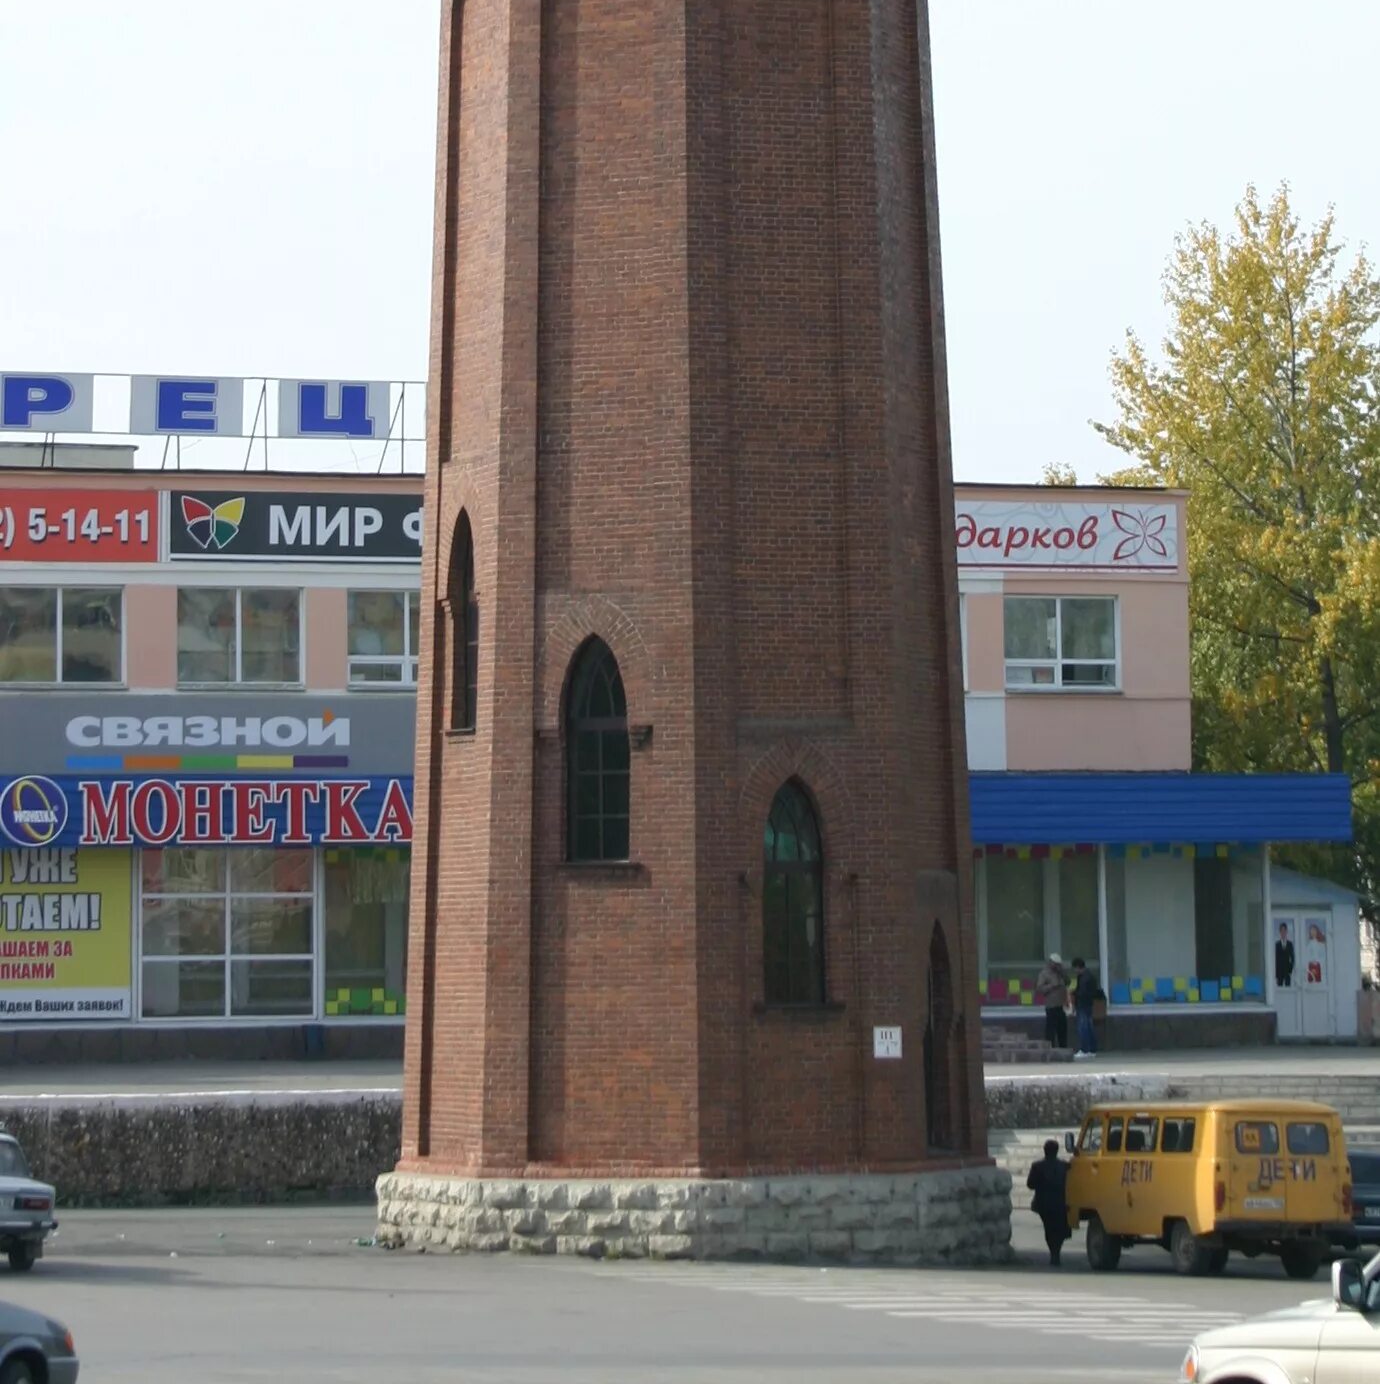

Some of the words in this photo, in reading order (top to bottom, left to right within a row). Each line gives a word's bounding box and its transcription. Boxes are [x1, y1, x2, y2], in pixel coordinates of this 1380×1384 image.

[28, 508, 150, 543] 5-14-11
[269, 505, 383, 547] МИР
[955, 513, 1099, 558] дарков
[65, 707, 350, 747] СВЯЗНОЙ
[79, 779, 414, 844] МОНЕТКА
[11, 848, 78, 884] УЖЕ
[0, 892, 102, 931] ТАЕМ!
[0, 941, 49, 957] ШАЕМ
[53, 940, 73, 957] ЗА
[35, 999, 74, 1012] Ваших
[77, 998, 124, 1011] заявок!
[1121, 1160, 1153, 1186] ДЕТИ
[1258, 1158, 1317, 1184] ДЕТИ
